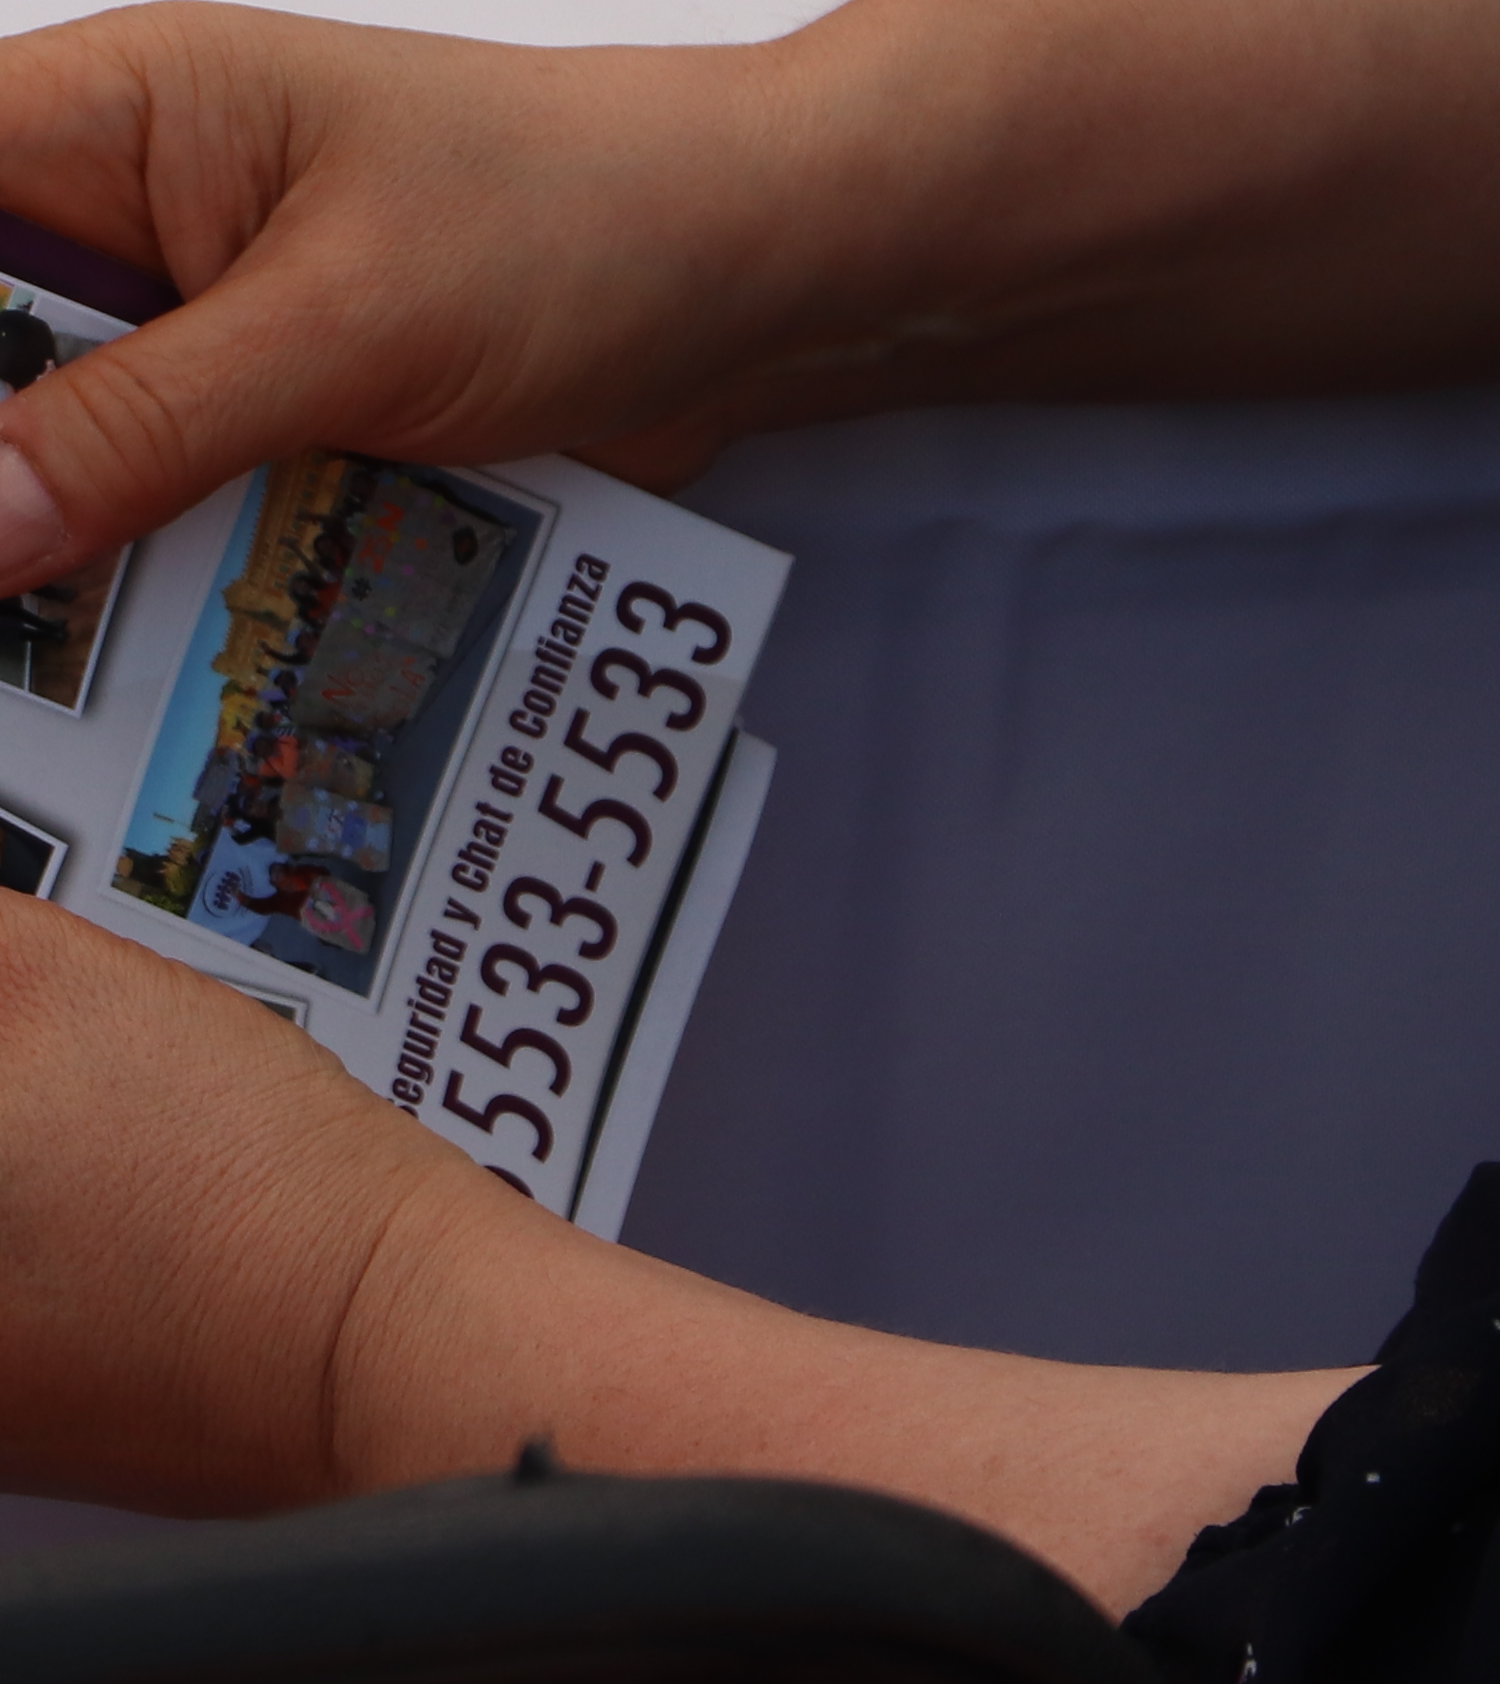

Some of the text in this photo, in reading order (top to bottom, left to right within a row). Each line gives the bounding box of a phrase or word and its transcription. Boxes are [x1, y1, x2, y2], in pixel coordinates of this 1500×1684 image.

[393, 553, 609, 1118] eguridad y Chat de Confianza
[442, 581, 731, 1162] 5533-5533
